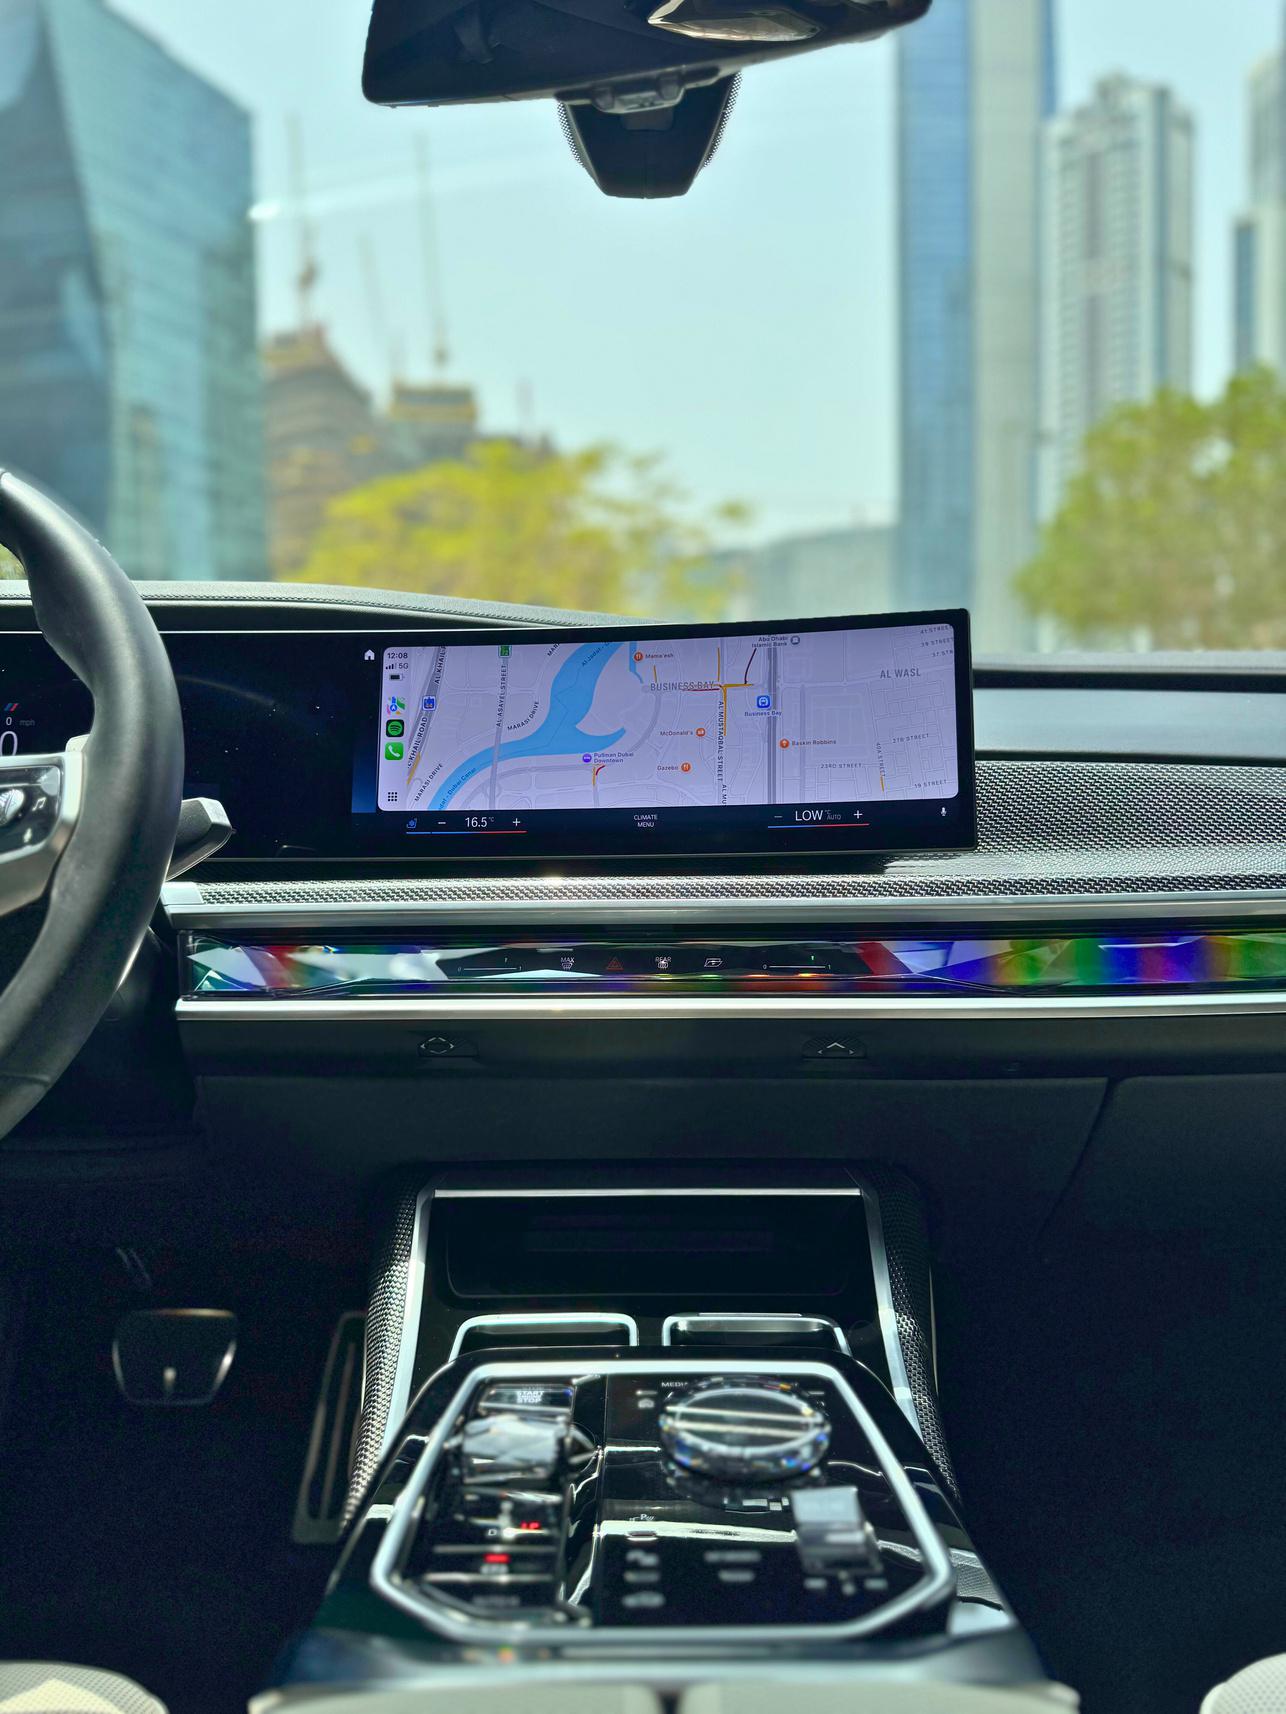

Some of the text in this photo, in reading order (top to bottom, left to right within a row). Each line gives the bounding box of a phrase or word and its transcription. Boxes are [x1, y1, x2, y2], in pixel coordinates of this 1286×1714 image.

[436, 651, 446, 674] KHAIL
[880, 668, 921, 678] AL WASL
[650, 681, 714, 691] BUSINESS BAY
[718, 701, 724, 710] AL
[5, 716, 12, 726] 0
[507, 701, 539, 731] MARASI DRIVE
[408, 740, 421, 763] KHAIL
[417, 717, 428, 738] ROAD
[906, 733, 929, 742] STREET
[414, 763, 443, 801] MARASI DRIVE
[923, 779, 947, 787] STREET
[721, 784, 727, 793] AL
[795, 810, 823, 821] LOW
[464, 816, 488, 828] 16.5
